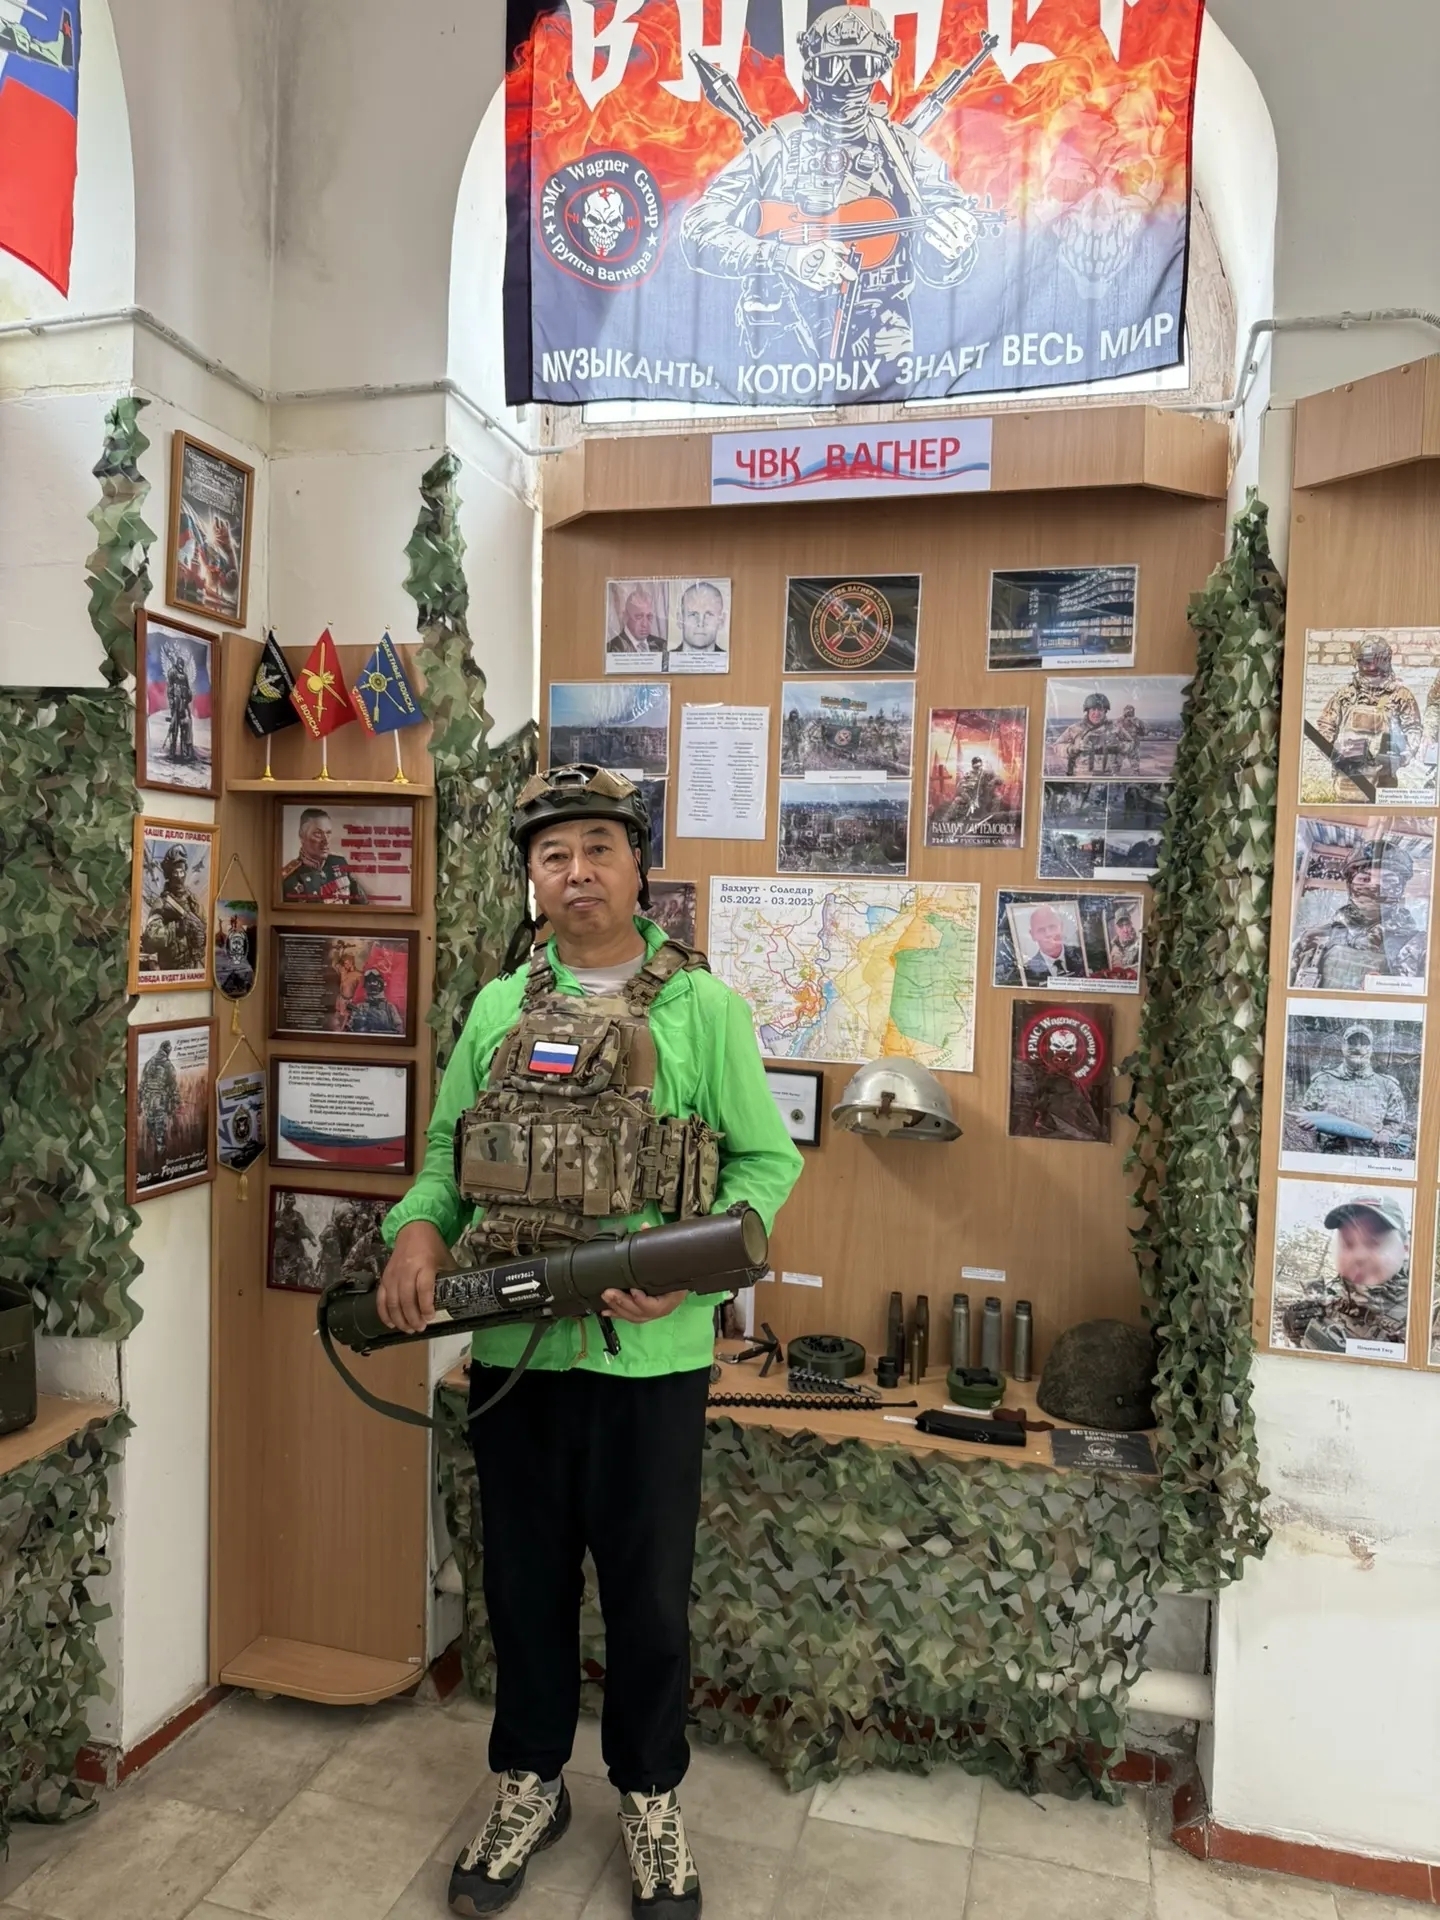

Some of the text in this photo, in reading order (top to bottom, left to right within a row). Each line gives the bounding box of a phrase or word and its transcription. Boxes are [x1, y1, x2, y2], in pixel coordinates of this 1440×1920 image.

[543, 159, 659, 229] PMC Wagner Group
[551, 233, 652, 281] Группа Вагнера
[542, 312, 1174, 395] МУЗЫКАНТЫ, КОТОРЫХ ЗНАЕТ ВЕСЬ МИР
[735, 437, 961, 480] ЧВК ВАГНЕР
[381, 638, 402, 680] РАКЕТНЫЕ
[398, 681, 416, 713] ВОЙСКА
[300, 704, 321, 737] ВОЙСКА
[165, 829, 184, 840] ДЕЛО
[720, 895, 761, 904] 05.2022
[771, 896, 814, 906] 03.2023
[721, 884, 760, 893] Бахмут
[770, 885, 814, 896] Соледар
[1028, 1017, 1096, 1055] PMC Wagner Group
[161, 1163, 188, 1179] Родина
